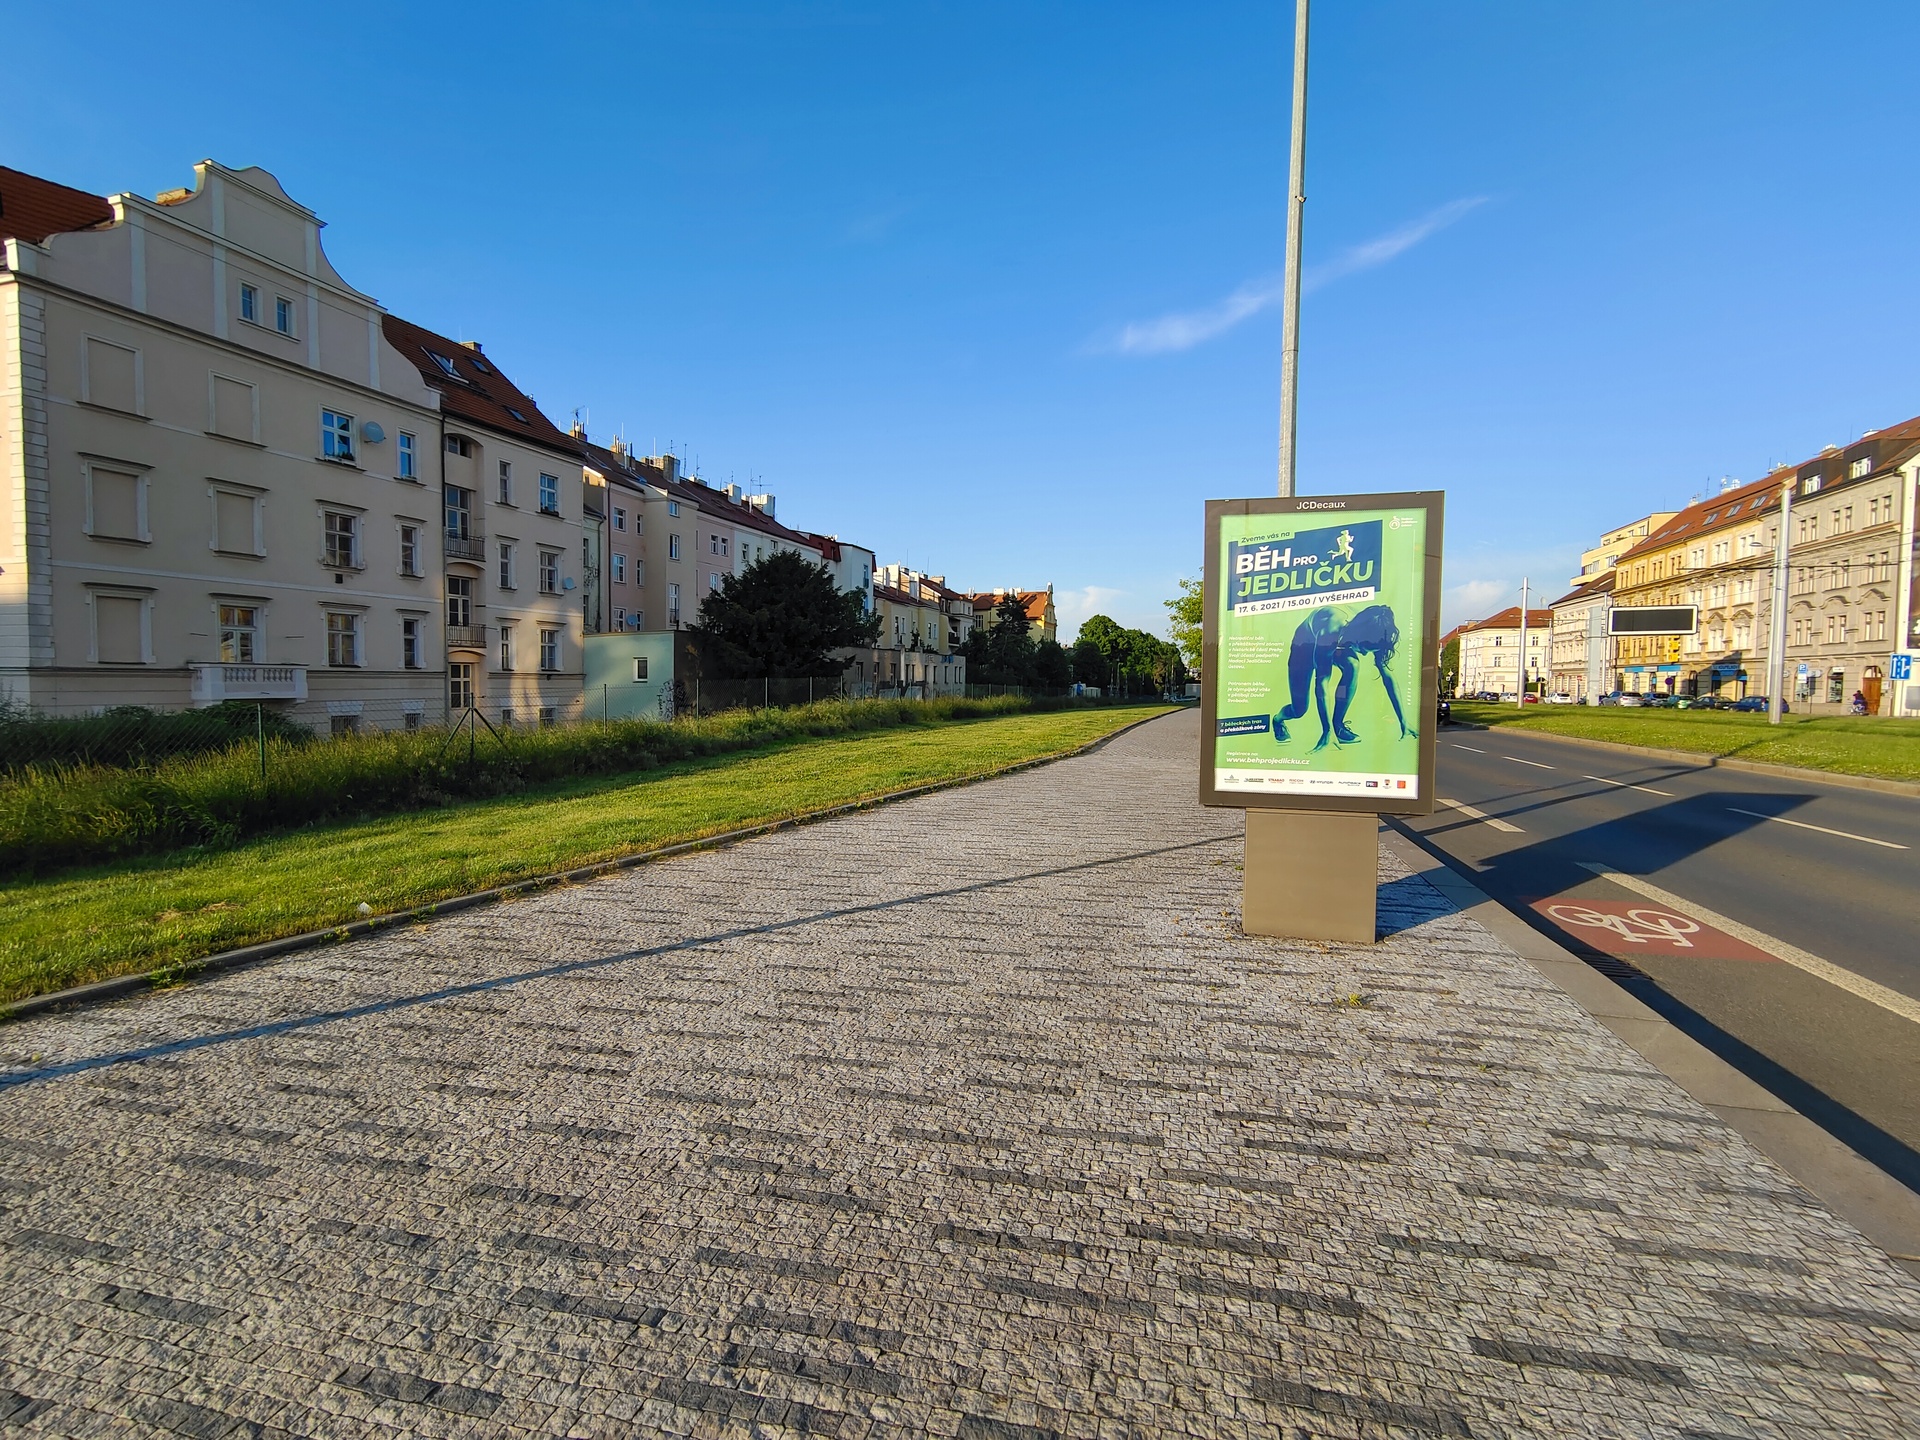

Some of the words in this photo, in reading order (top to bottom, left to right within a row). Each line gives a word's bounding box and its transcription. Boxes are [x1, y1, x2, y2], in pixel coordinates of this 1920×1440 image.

[1296, 501, 1346, 510] JCDecaux
[1236, 545, 1291, 574] BĚH
[1293, 555, 1318, 567] PRO
[1237, 560, 1374, 597] JEDLIČKU
[1260, 602, 1280, 610] 2021
[1287, 598, 1311, 607] 15.00
[1318, 591, 1369, 603] VYŠEHRAD
[1226, 757, 1310, 765] www.behprojedlicku.cz
